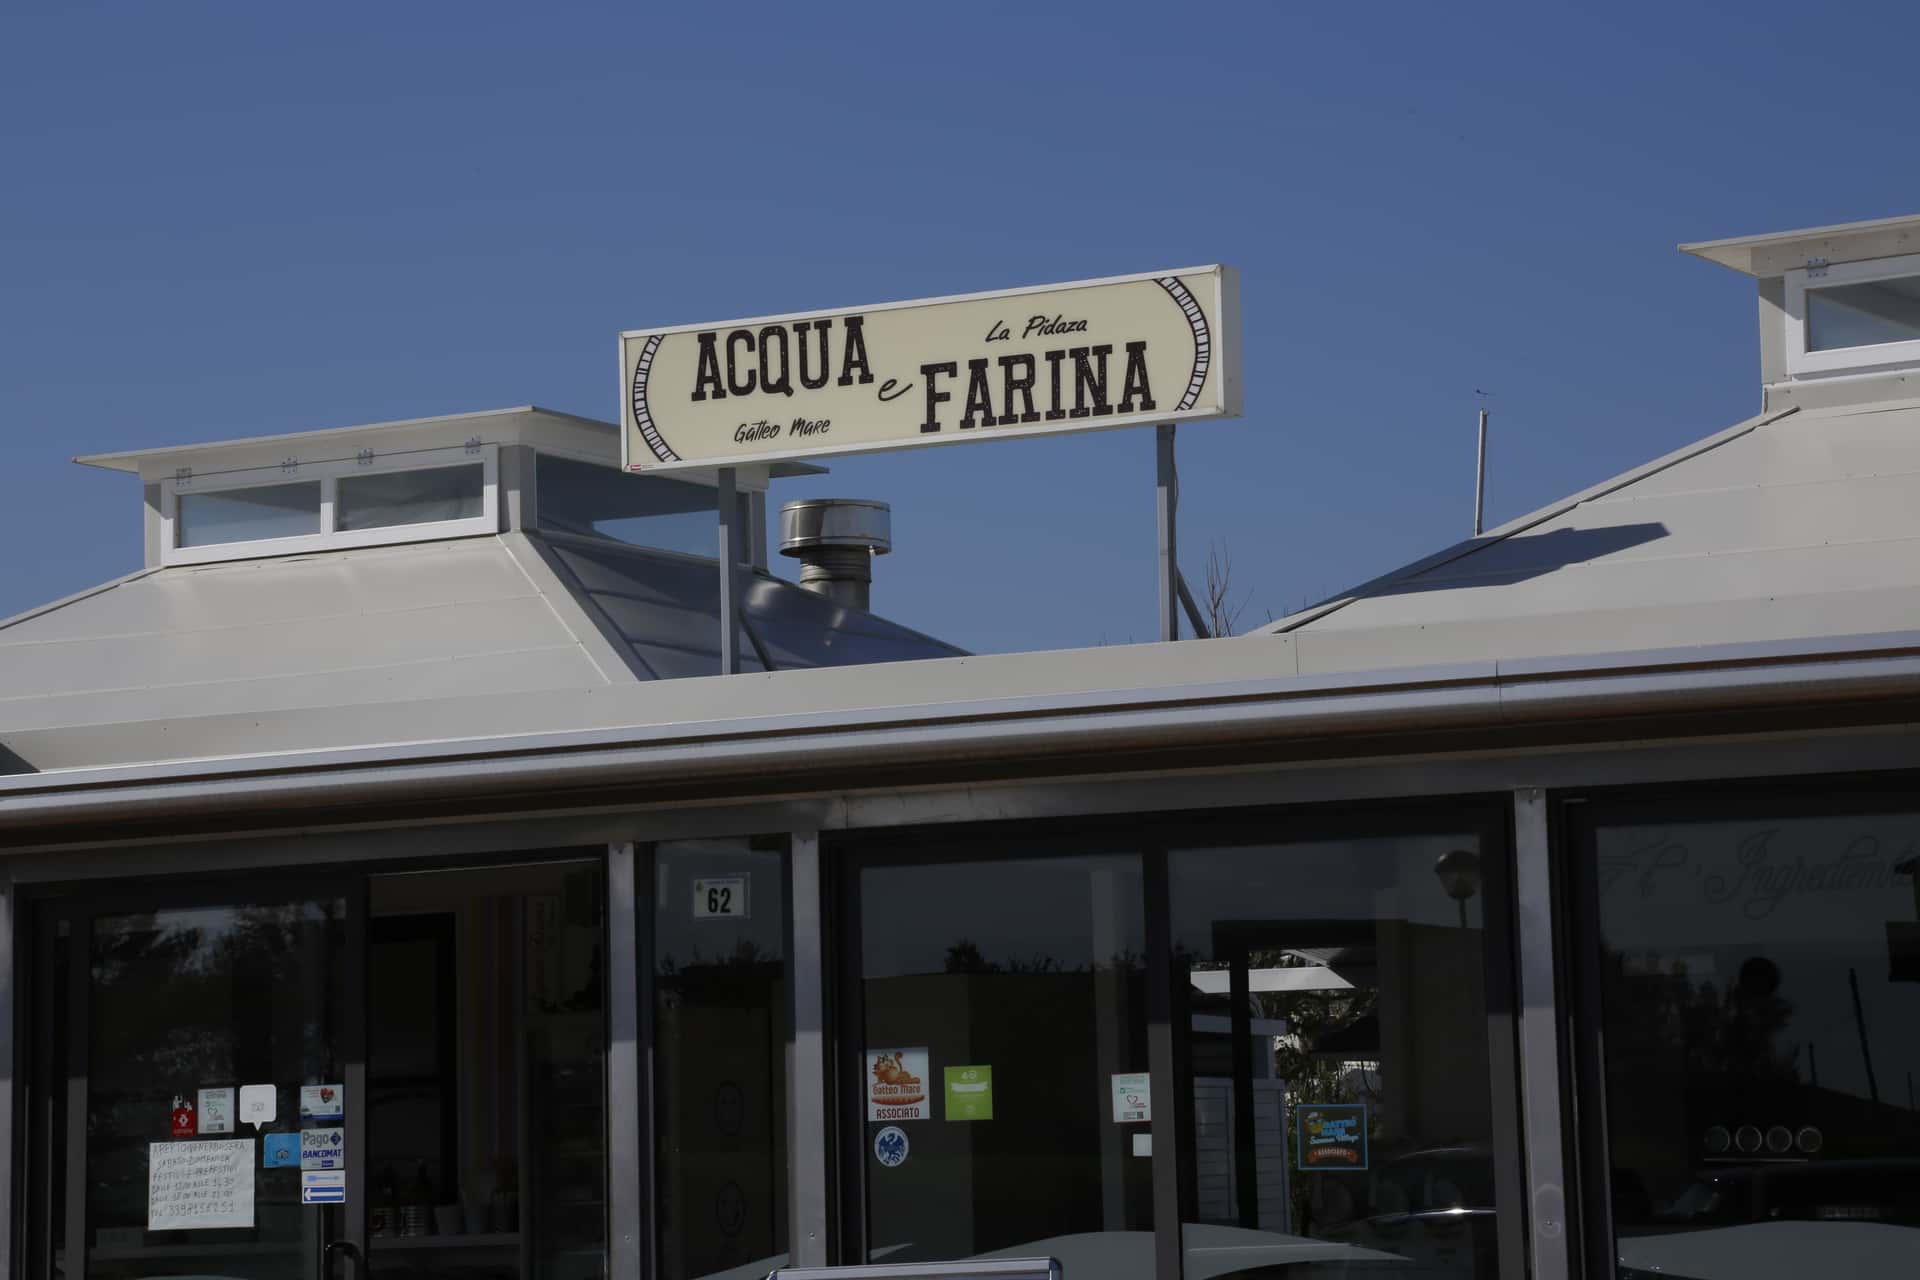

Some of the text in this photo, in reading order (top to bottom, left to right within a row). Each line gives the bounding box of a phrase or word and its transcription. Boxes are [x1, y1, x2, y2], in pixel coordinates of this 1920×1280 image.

[985, 316, 1088, 342] La Pidaza
[691, 316, 1156, 434] ACQUA e FARINA
[734, 420, 782, 444] Gatteo
[708, 887, 731, 913] 62
[876, 1107, 920, 1119] ASSOCIATO
[303, 1131, 329, 1147] Pago
[303, 1149, 341, 1159] BANCOMAT
